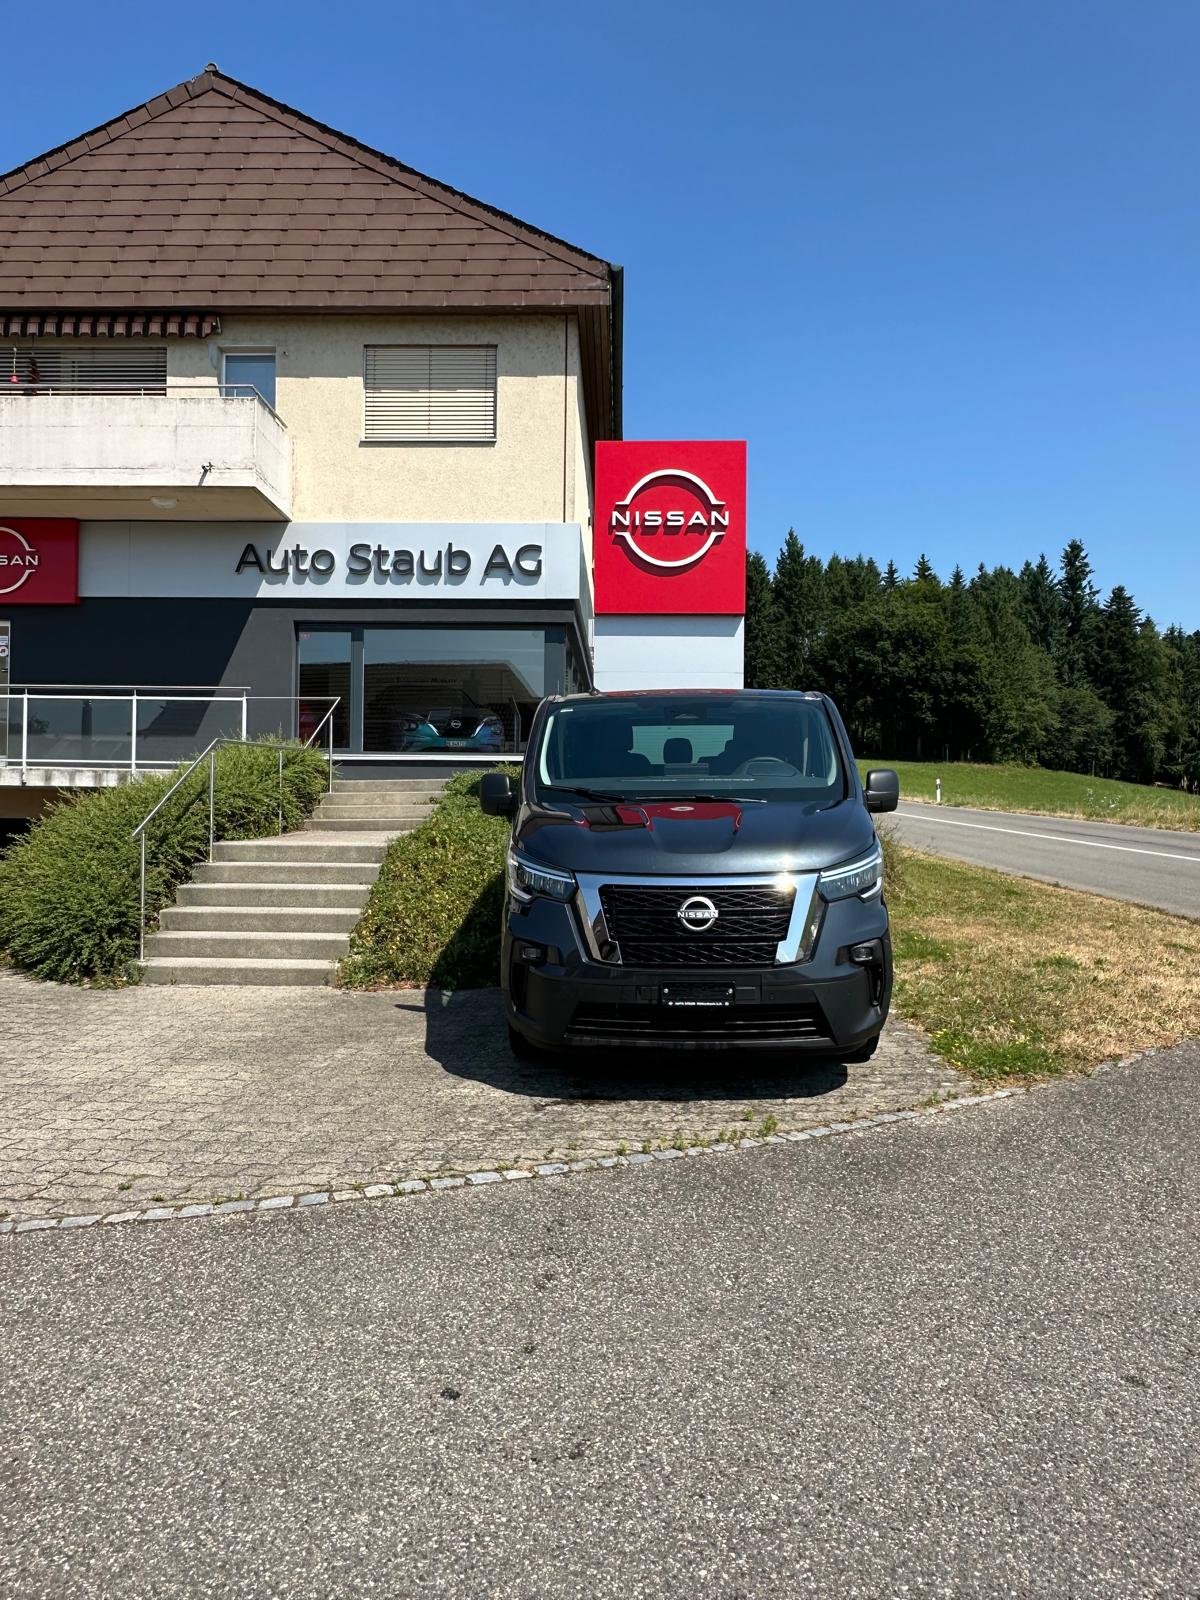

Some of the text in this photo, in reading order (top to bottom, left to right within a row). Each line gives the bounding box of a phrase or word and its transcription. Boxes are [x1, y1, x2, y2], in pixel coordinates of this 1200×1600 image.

[611, 510, 730, 526] NISSAN
[234, 542, 543, 577] Auto Staub AG
[677, 910, 719, 919] NISSAN
